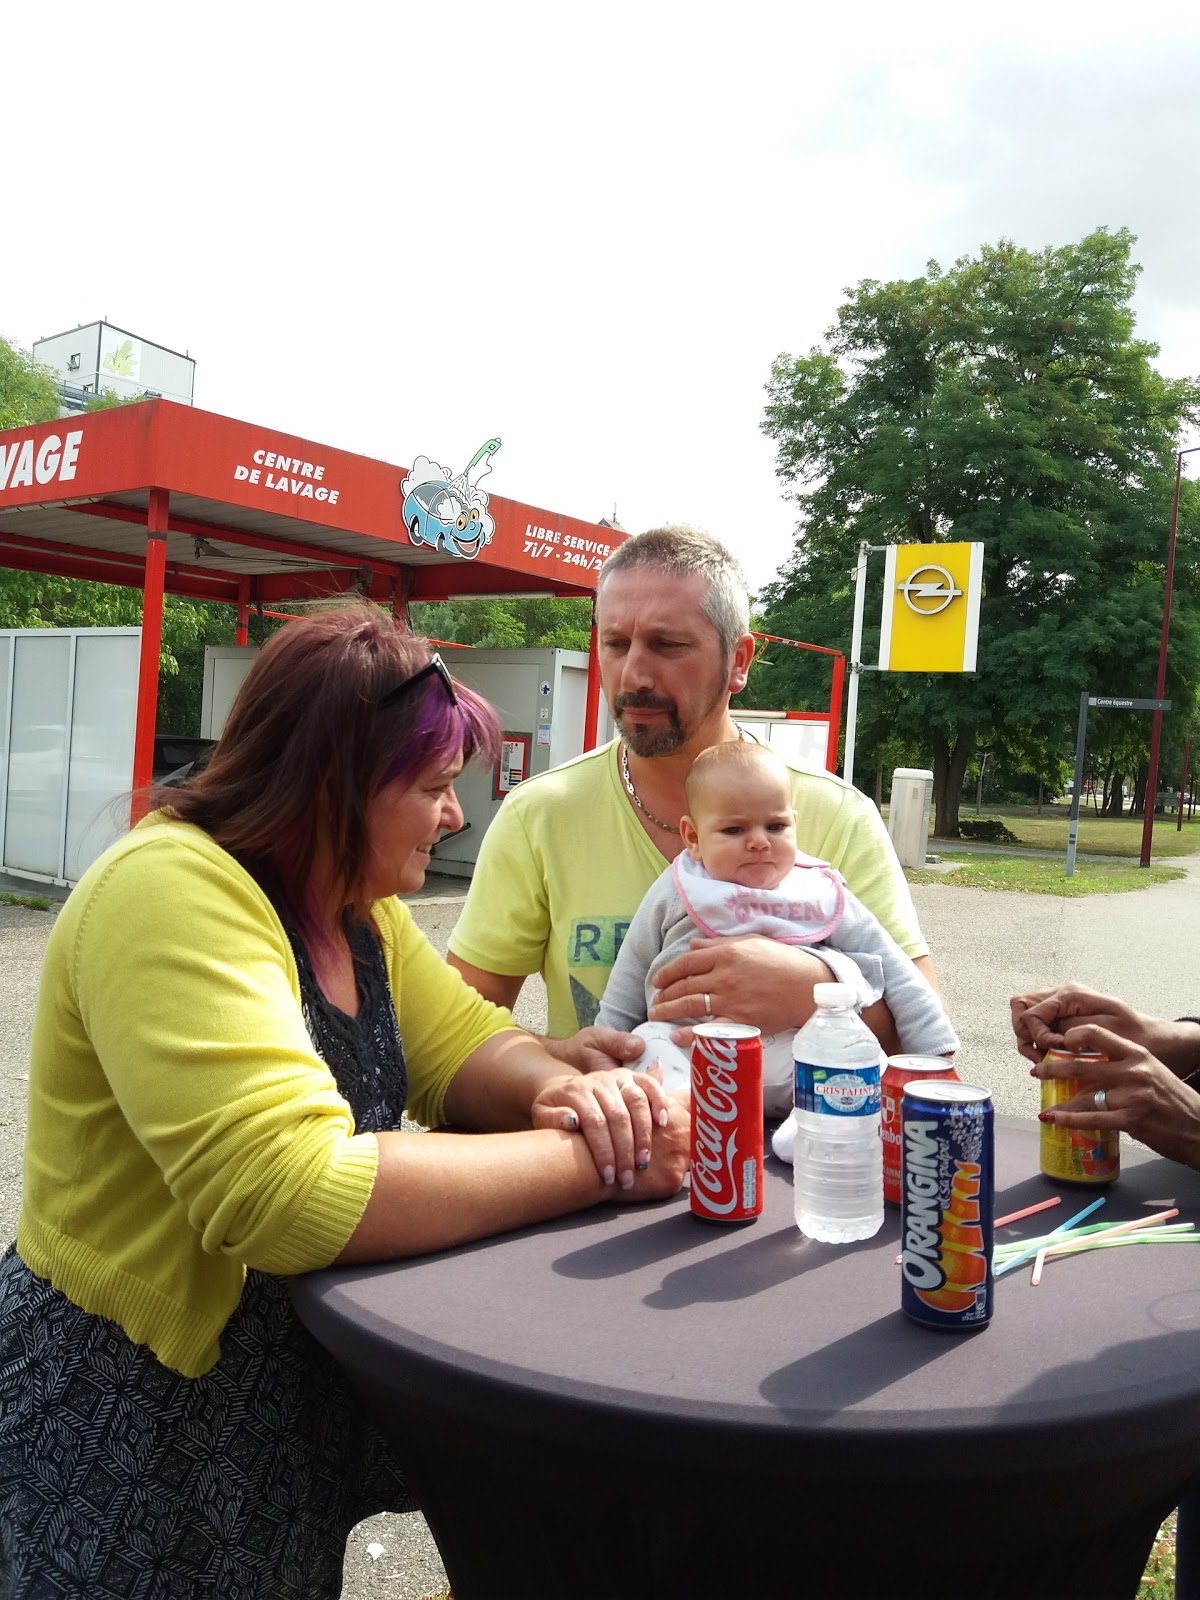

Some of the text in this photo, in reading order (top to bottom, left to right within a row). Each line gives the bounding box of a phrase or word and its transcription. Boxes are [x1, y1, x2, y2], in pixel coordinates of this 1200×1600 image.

[253, 449, 325, 481] CENTRE
[234, 465, 340, 505] DE LAVAGE
[523, 540, 555, 558] 7i/7
[562, 551, 603, 571] 24h/2
[525, 524, 611, 556] LIBRE SERVICE
[1097, 698, 1134, 707] Centre équestre
[816, 1085, 873, 1097] CRISTALINE
[902, 1120, 943, 1289] ORANGINA
